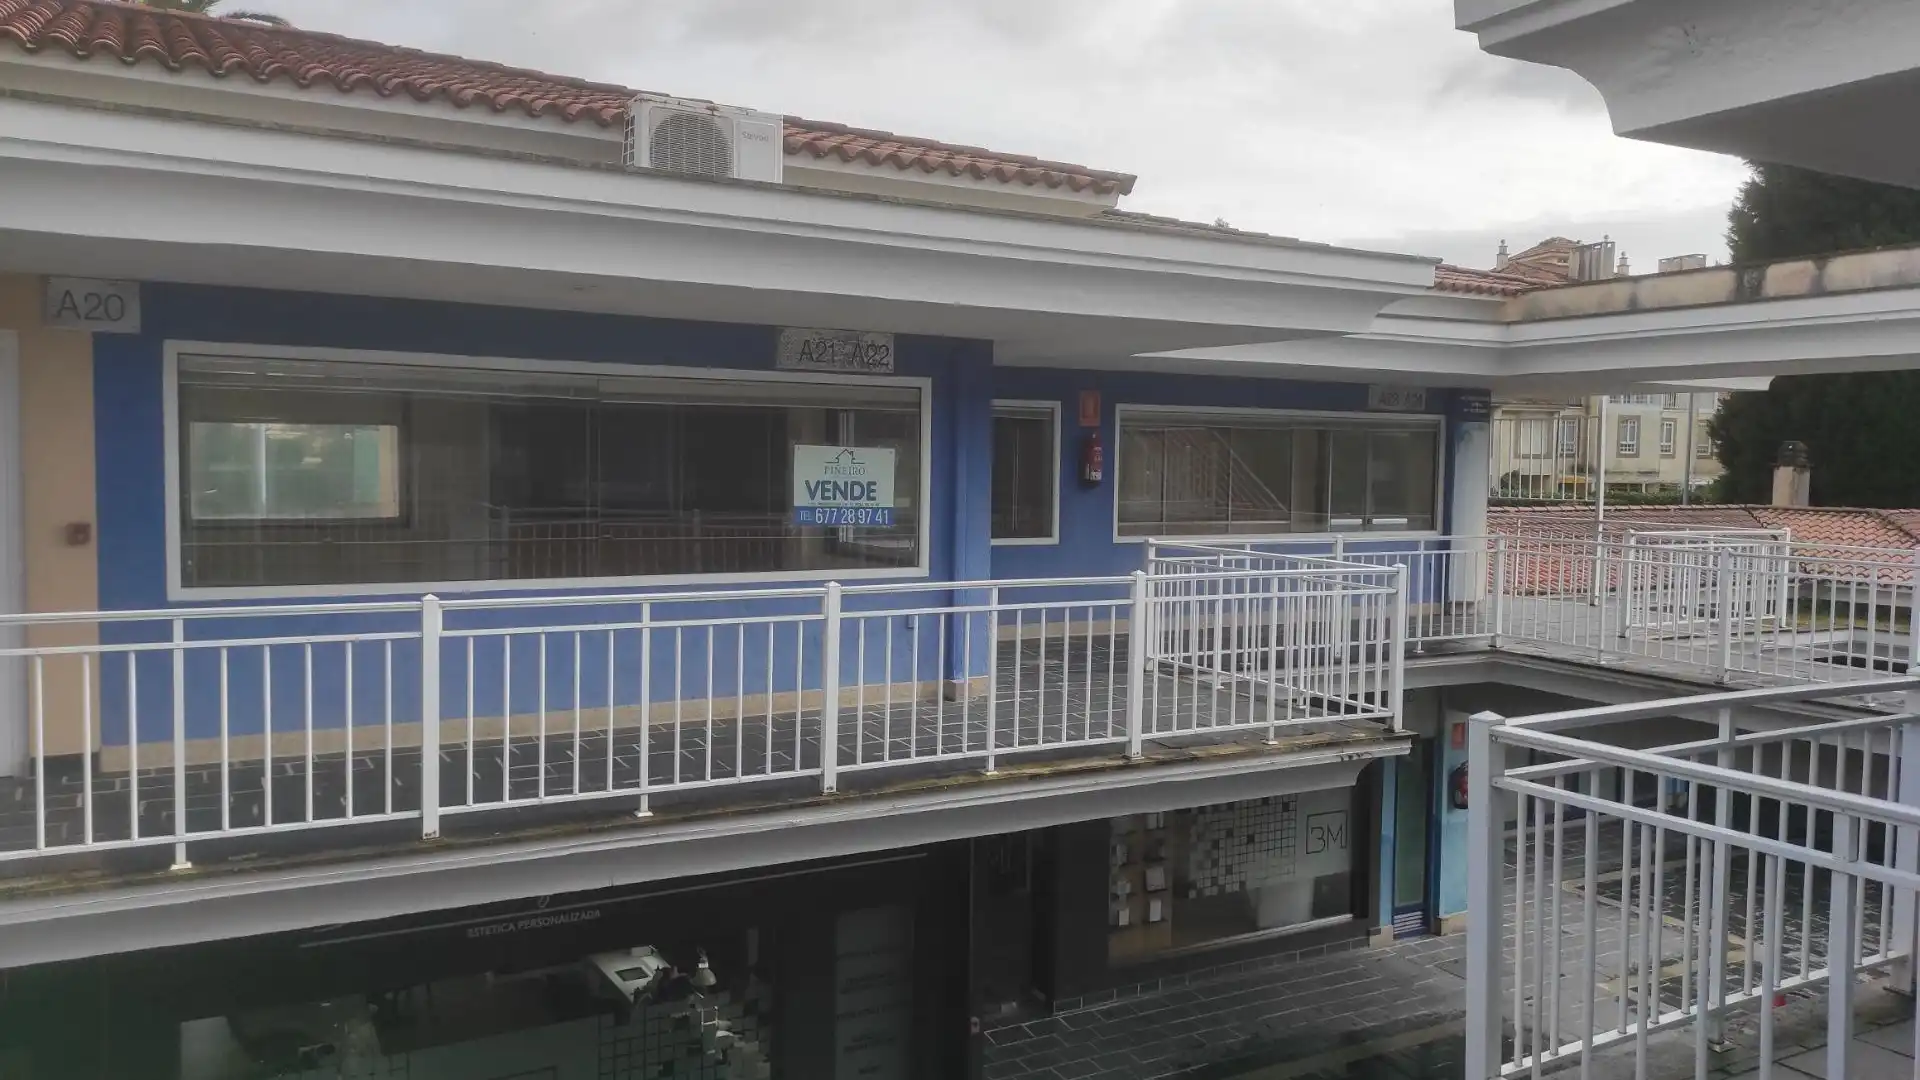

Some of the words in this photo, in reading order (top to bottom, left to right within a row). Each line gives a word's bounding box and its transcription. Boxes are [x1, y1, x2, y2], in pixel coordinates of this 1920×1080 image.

[54, 289, 125, 322] A20
[799, 339, 836, 364] A21
[851, 342, 890, 366] A22
[804, 479, 878, 501] VENDE
[815, 508, 838, 524] 677
[840, 508, 856, 524] 28
[858, 508, 873, 524] 97
[875, 508, 889, 525] 41
[517, 909, 602, 930] PERSONALIZADA
